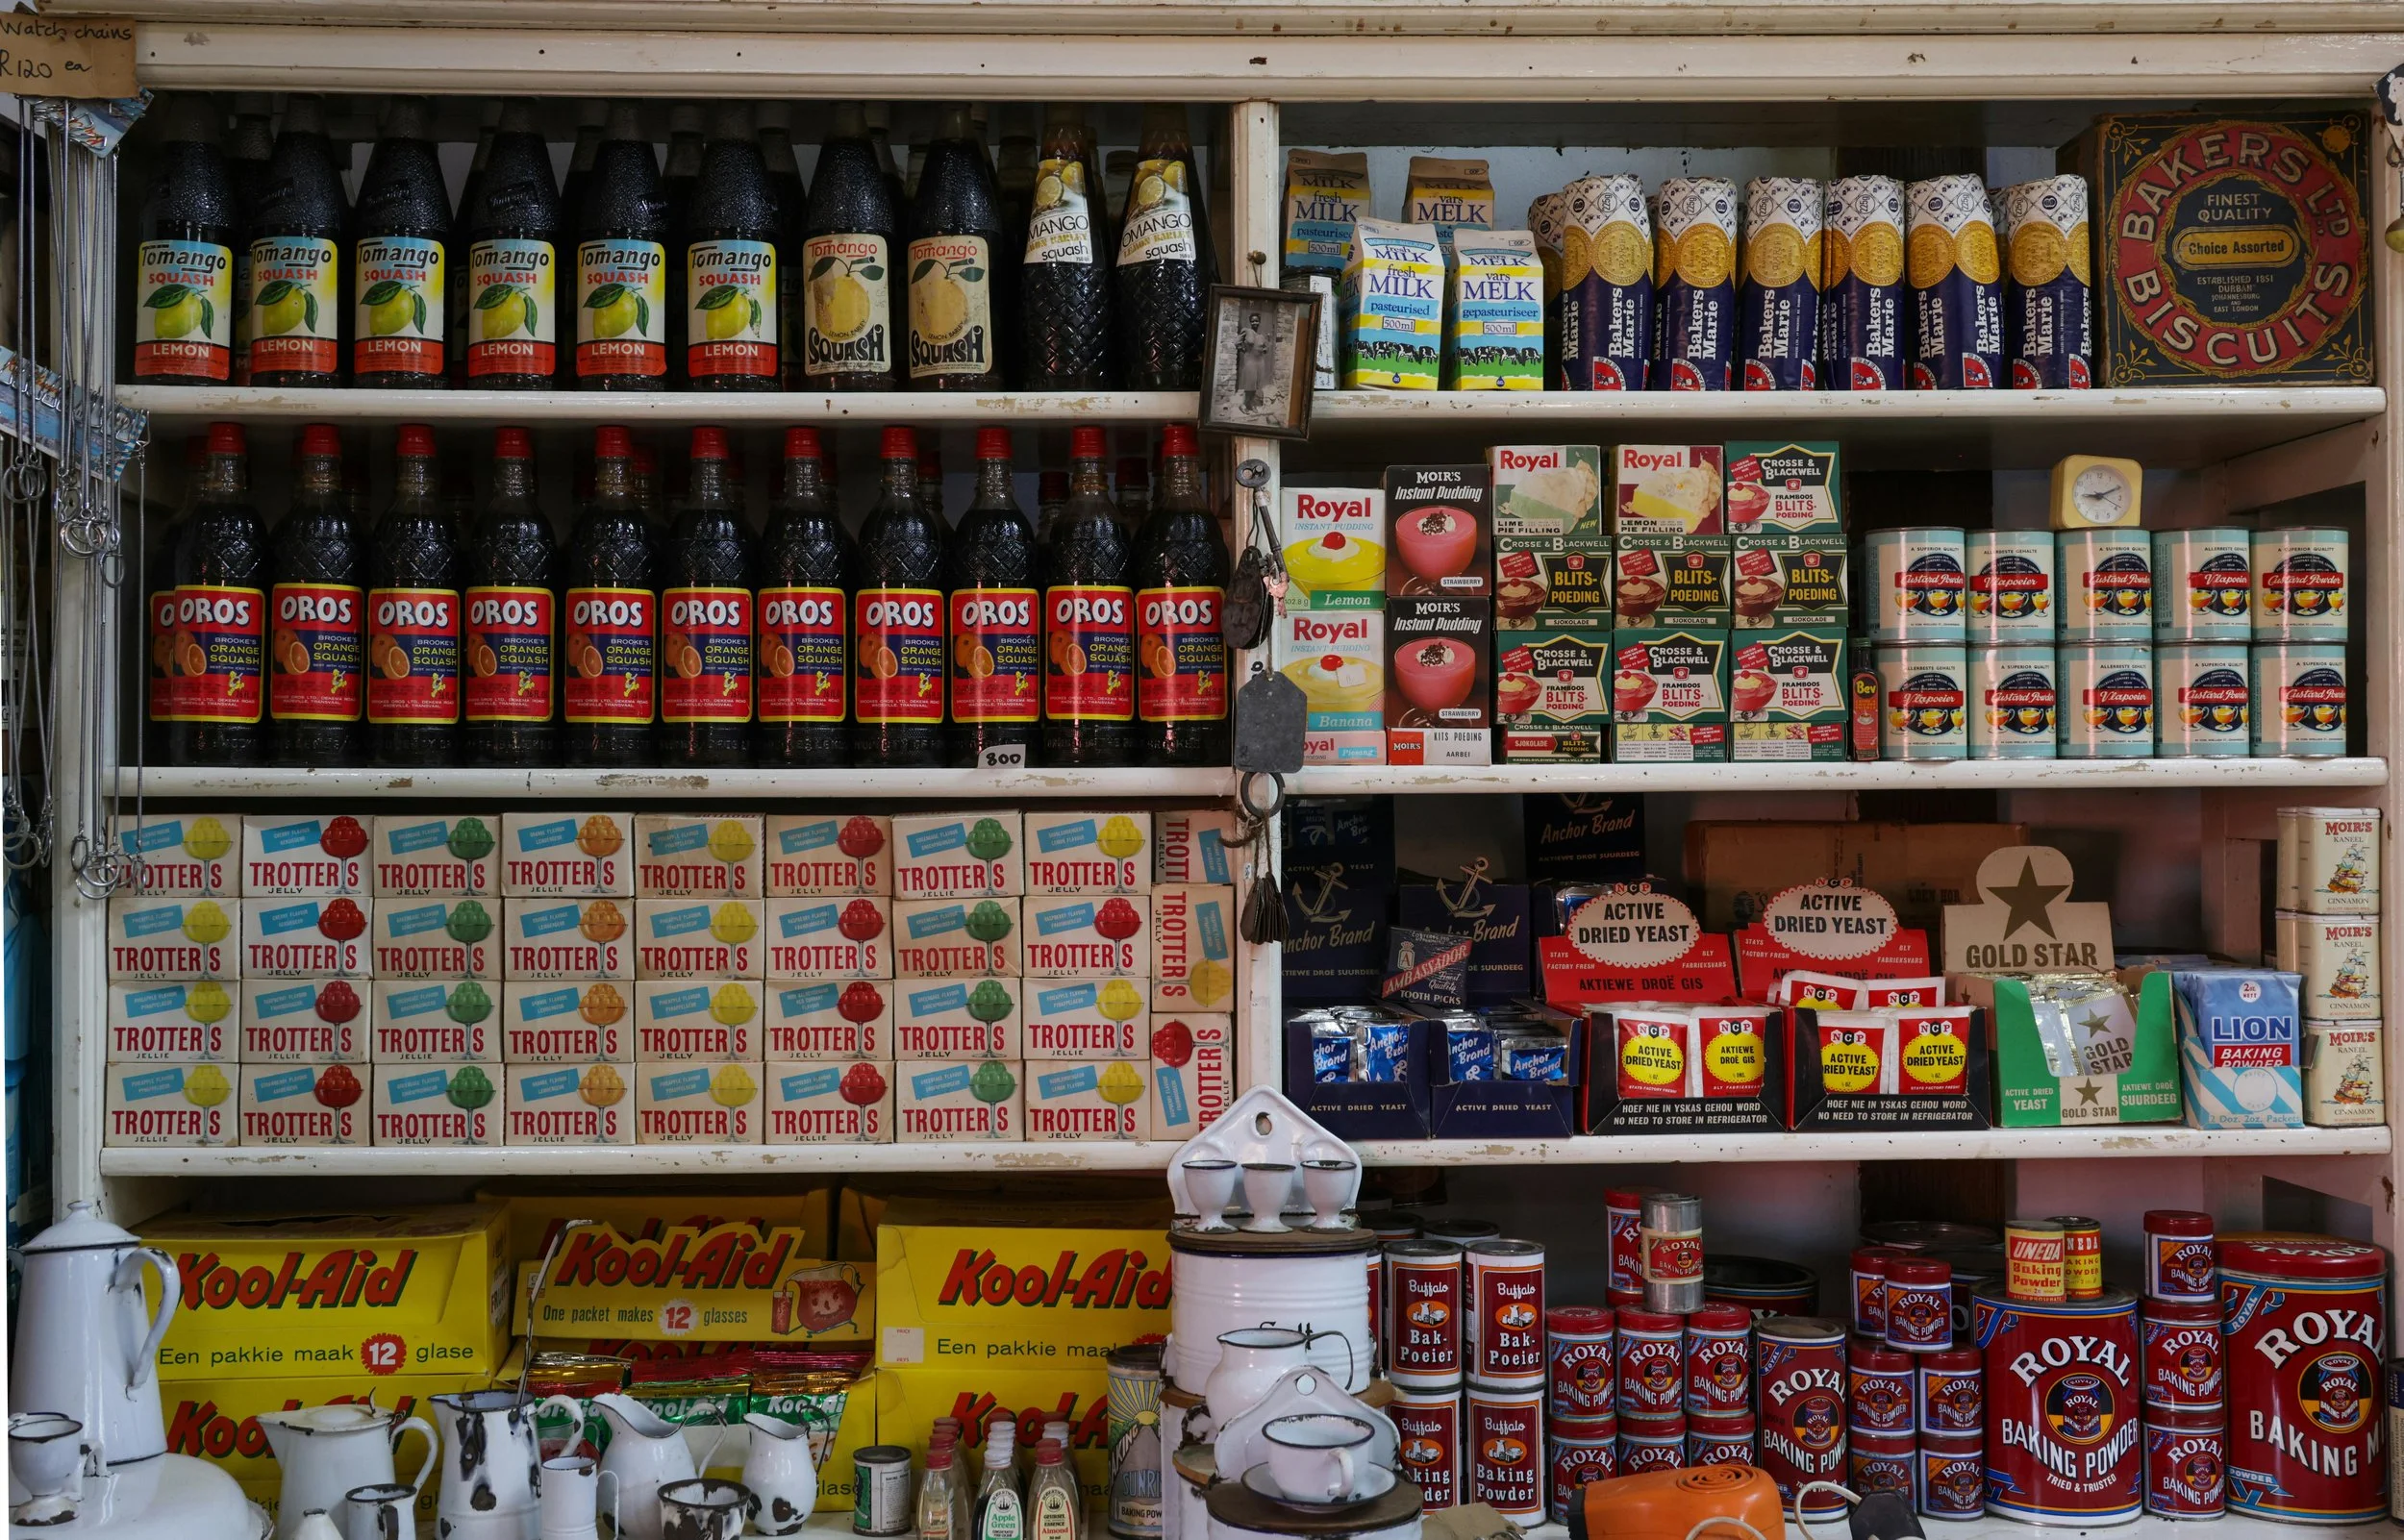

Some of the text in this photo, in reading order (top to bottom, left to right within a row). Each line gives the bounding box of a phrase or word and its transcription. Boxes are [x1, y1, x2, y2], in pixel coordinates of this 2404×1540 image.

[1, 19, 133, 40] Watch chains
[0, 48, 92, 79] R120 ea
[2121, 132, 2311, 243] BAKERS
[1314, 191, 1342, 204] fresh
[1440, 195, 1464, 204] vars
[2207, 194, 2258, 207] FINEST
[1294, 201, 1360, 222] MILK
[1417, 203, 1487, 223] MELK
[2197, 208, 2272, 222] QUALITY
[358, 241, 439, 268] Tomango
[808, 240, 878, 258] Tomango
[1041, 243, 1089, 261] squash
[2189, 240, 2284, 255] Choice Assorted
[141, 243, 226, 273] Tomango
[364, 271, 427, 281] SQUASH
[1387, 264, 1415, 277] fresh
[1486, 272, 1510, 281] vars
[149, 272, 214, 286] SQUASH
[1369, 275, 1434, 298] MILK
[2197, 275, 2273, 285] ESTABLISHED 1851
[1464, 281, 1535, 300] MELK
[1370, 302, 1430, 315] pasteurised
[1463, 308, 1539, 318] gepasteuriseer
[2126, 261, 2350, 365] BISCUITS
[828, 319, 866, 339] LEMON BARLEY
[1385, 319, 1414, 331] 500ml
[1485, 325, 1515, 334] 500ml
[1609, 288, 1623, 359] Bakers
[1622, 299, 1635, 360] Marie
[1688, 289, 1704, 360] Bakers
[1704, 301, 1718, 360] Marie
[153, 343, 210, 357] LEMON
[367, 341, 422, 353] LEMON
[809, 325, 885, 366] SQUASH
[1501, 450, 1559, 472] Royal
[1416, 472, 1461, 482] MOIR'S
[1395, 486, 1483, 502] Instant Pudding
[1297, 494, 1371, 522] Royal
[1580, 519, 1597, 530] NEW
[1555, 572, 1597, 585] BLITS-
[2267, 574, 2341, 584] Custard Powder
[1324, 594, 1371, 606] Lemon
[1552, 591, 1599, 603] POEDING
[281, 595, 352, 624] OROS
[471, 600, 538, 626] OROS
[313, 642, 360, 653] ORANGE
[500, 646, 548, 655] ORANGE
[1534, 650, 1576, 660] CROSSE
[313, 652, 360, 662] SQUASH
[500, 655, 549, 664] SQUASH
[1538, 658, 1593, 670] BLACKWELL
[1857, 681, 1876, 694] Bev
[1319, 716, 1372, 728] Banana
[1454, 733, 1482, 741] POEDING
[1393, 742, 1422, 751] MOIR'S
[986, 752, 1021, 766] 800
[2325, 822, 2372, 835] MOIR'S
[1604, 903, 1665, 920] ACTIVE
[1579, 926, 1690, 944] DRIED YEAST
[1966, 943, 2097, 969] GOLD STAR
[1386, 944, 1468, 994] AMBASSADOR
[1580, 976, 1703, 990] AKTIEWE DROË GIS
[1400, 990, 1461, 1005] TOOTH PICKS
[2213, 1016, 2291, 1041] LION
[2221, 1047, 2283, 1059] BAKING
[1514, 1053, 1549, 1072] Anchor
[1529, 1060, 1562, 1078] Brand
[1827, 1100, 1847, 1108] HOEF
[1880, 1100, 1907, 1109] YSKAS
[1911, 1101, 1939, 1109] GEHOU
[2121, 1094, 2176, 1105] SUURDEEG
[2219, 1114, 2300, 1124] Doz. Packets
[2014, 1240, 2061, 1260] UNEDA
[554, 1230, 795, 1289] Kool-Aid
[2013, 1262, 2061, 1277] Baking
[1408, 1279, 1448, 1296] Buffalo
[2013, 1277, 2061, 1288] Powder
[543, 1305, 747, 1329] One packet makes 12 glasses
[1410, 1330, 1447, 1346] Bak-
[2254, 1309, 2386, 1369] ROYAL
[160, 1342, 473, 1367] Een pakkie maak 12 glase
[1400, 1347, 1453, 1364] Poeier
[2010, 1335, 2130, 1388] ROYAL
[1485, 1417, 1525, 1435] Buffalo
[2002, 1418, 2139, 1478] BAKING POWDER
[2250, 1410, 2357, 1477] BAKING
[1477, 1463, 1534, 1483] Baking
[2046, 1473, 2116, 1493] TRIED & TRUSTED
[1477, 1483, 1534, 1502] Powder
[991, 1514, 1015, 1524] Apple
[991, 1521, 1015, 1529] Green
[1042, 1527, 1068, 1535] Almond
